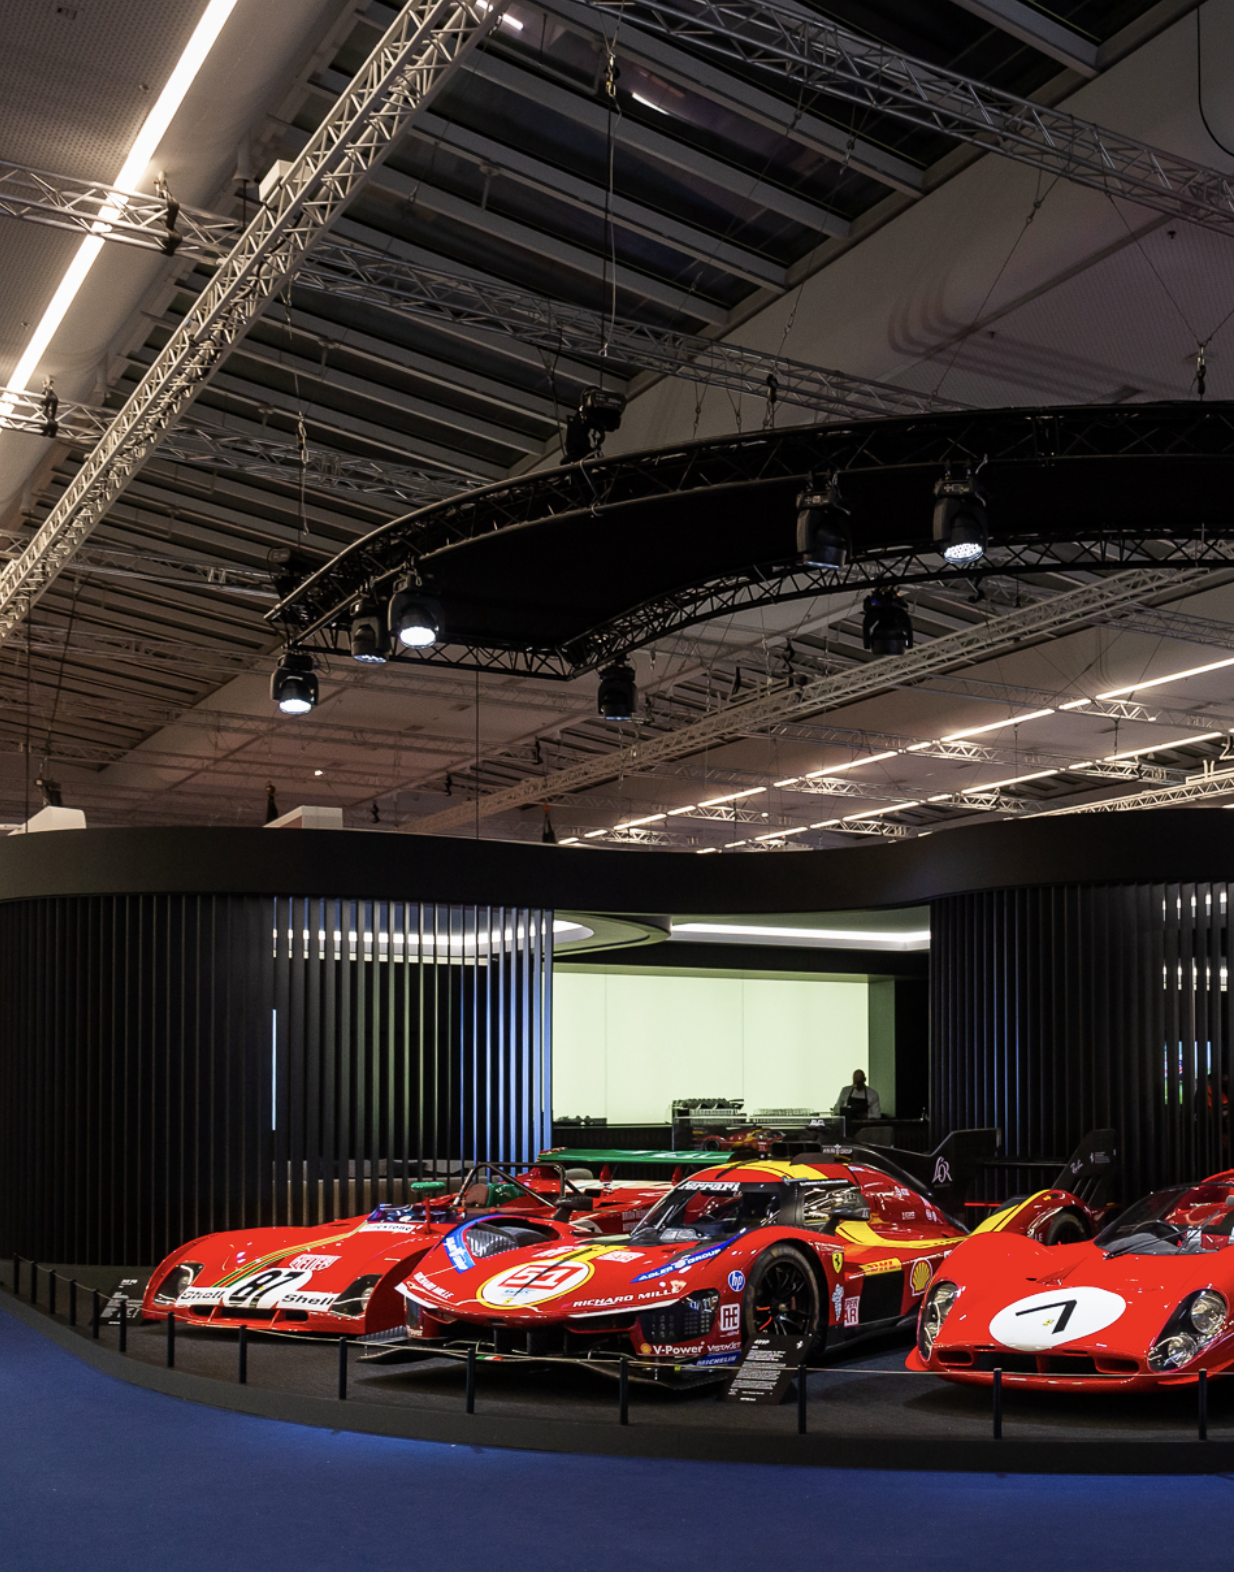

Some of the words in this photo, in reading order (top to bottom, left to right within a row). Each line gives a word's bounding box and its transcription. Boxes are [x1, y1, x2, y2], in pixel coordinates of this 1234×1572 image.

[678, 1181, 741, 1191] Ferrari
[639, 1266, 673, 1281] ADLER
[688, 1249, 721, 1264] GROUP
[870, 1261, 896, 1272] DHL
[500, 1265, 579, 1288] 51
[730, 1271, 743, 1290] hp
[229, 1270, 304, 1307] 87
[573, 1295, 633, 1307] RICHARD
[638, 1288, 681, 1300] MILLE
[282, 1294, 334, 1306] Shell
[1015, 1299, 1077, 1334] 7
[653, 1345, 703, 1354] V-Power
[697, 1356, 736, 1366] MICHELIN
